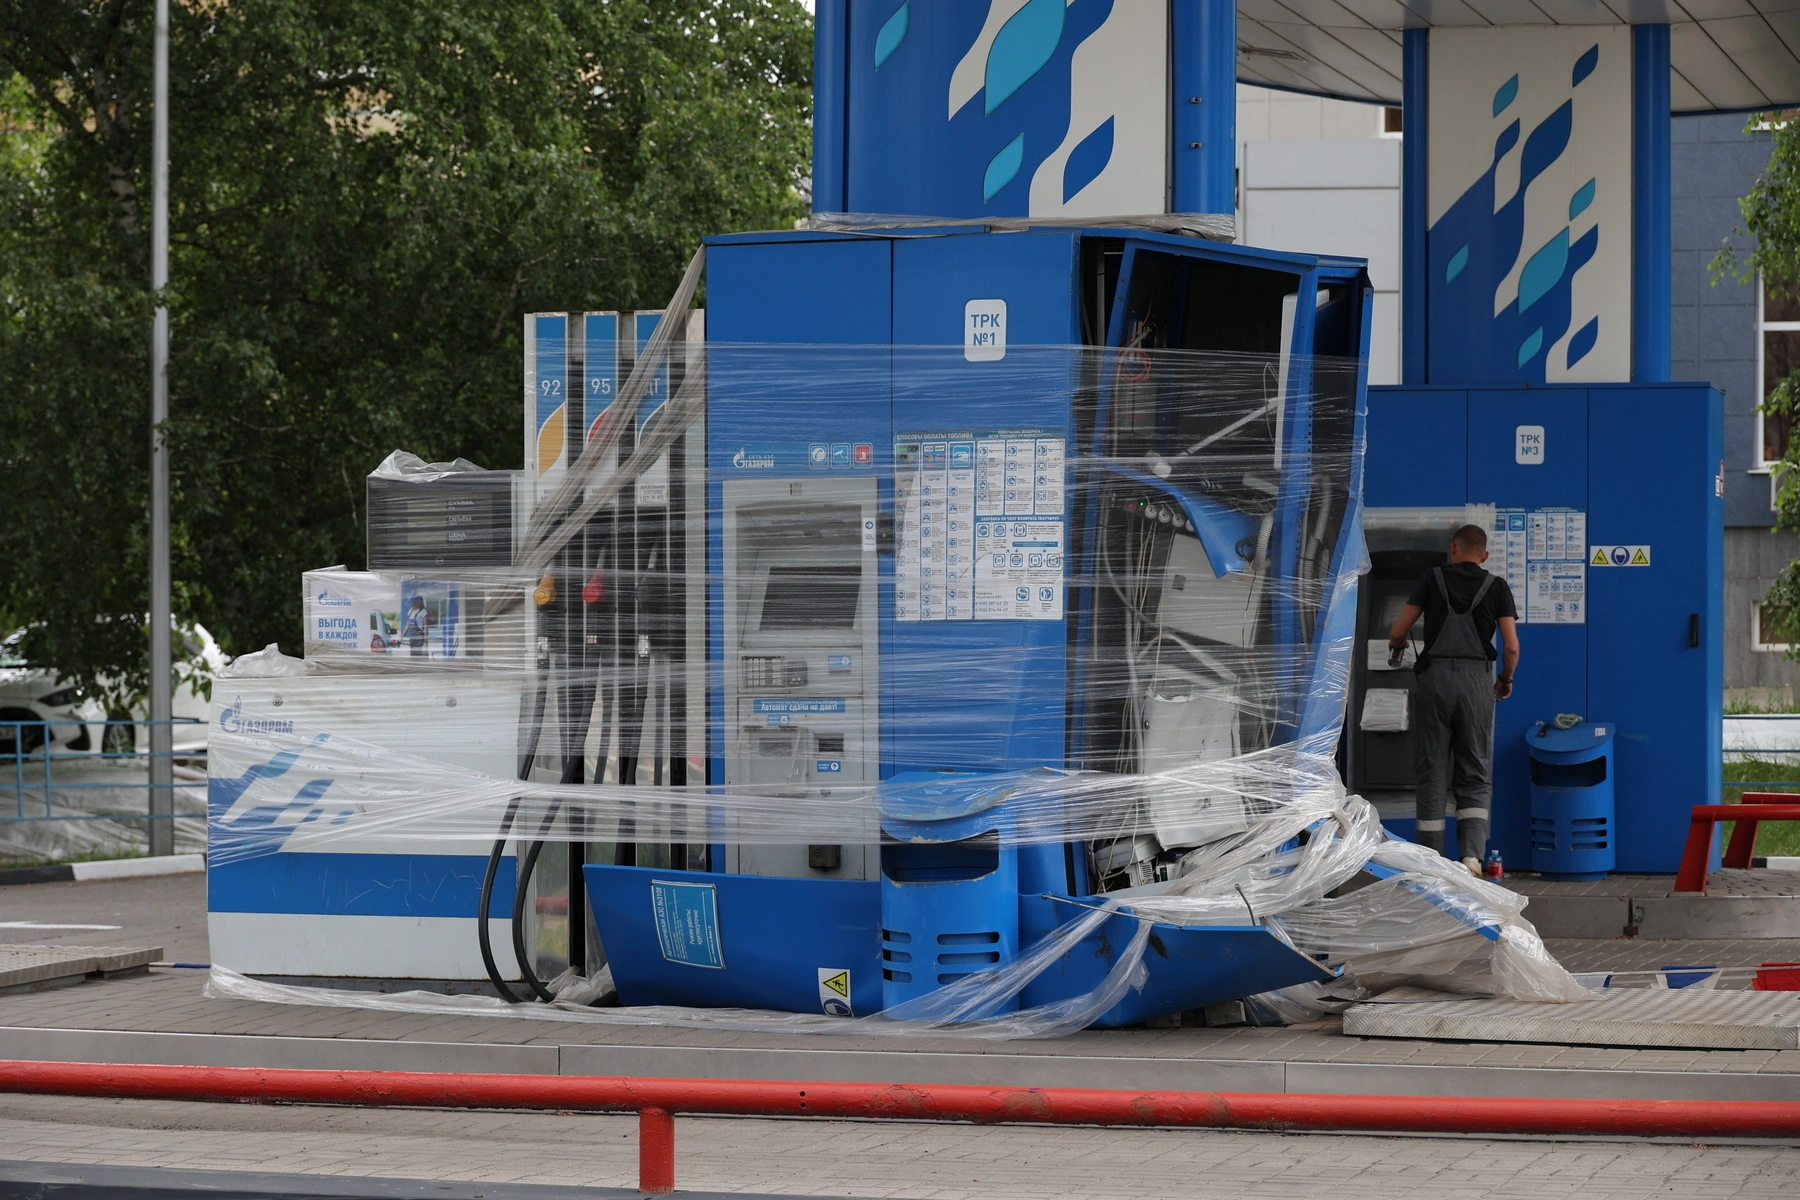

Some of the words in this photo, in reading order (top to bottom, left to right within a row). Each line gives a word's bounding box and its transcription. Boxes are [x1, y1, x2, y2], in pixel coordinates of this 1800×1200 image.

[971, 314, 1000, 328] ТРК
[973, 332, 995, 346] №1
[541, 379, 561, 396] 92
[591, 378, 611, 395] 95
[1520, 434, 1540, 444] ТРК
[1521, 446, 1539, 455] №3
[745, 460, 774, 468] ГАЗПРОМ
[318, 618, 357, 630] ВЫГОДА
[318, 631, 324, 639] В
[325, 630, 358, 641] КАЖДОЙ
[241, 719, 294, 734] ГАЗПРОМ
